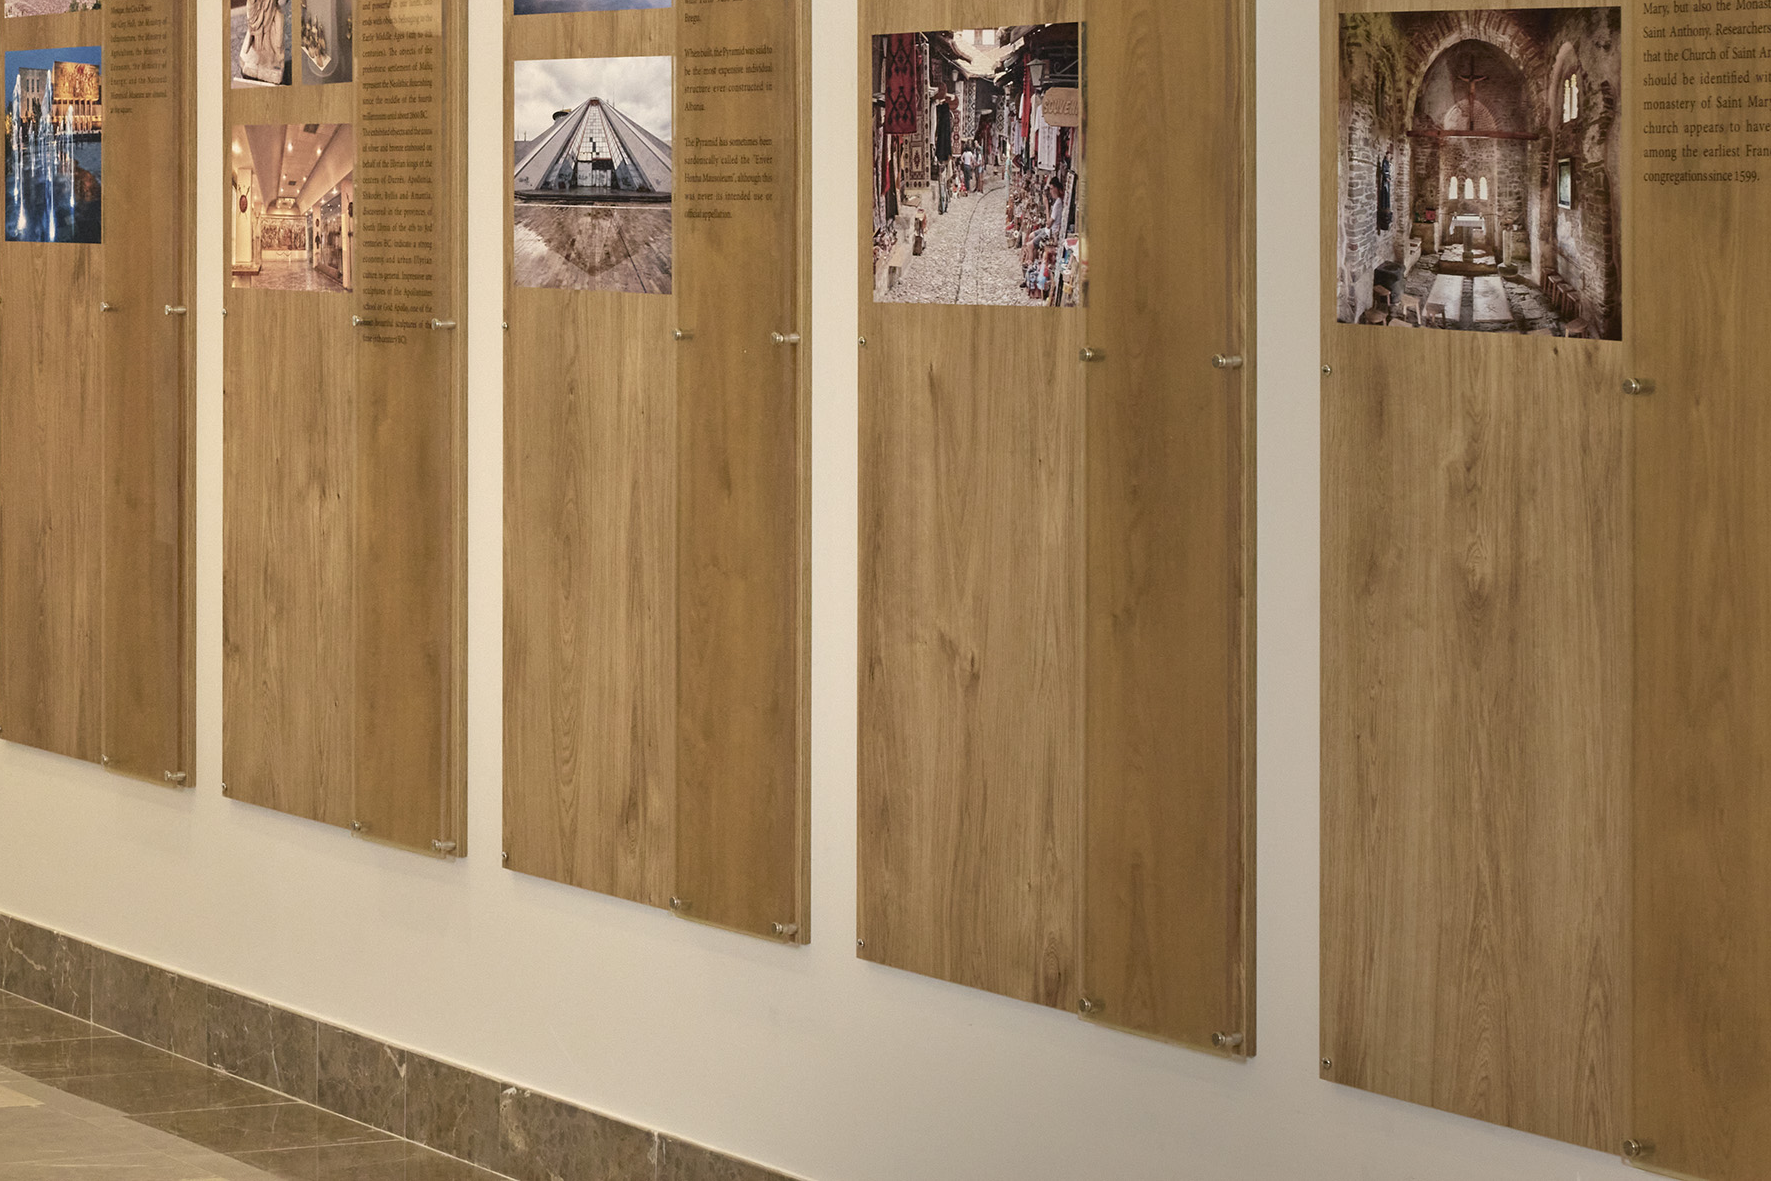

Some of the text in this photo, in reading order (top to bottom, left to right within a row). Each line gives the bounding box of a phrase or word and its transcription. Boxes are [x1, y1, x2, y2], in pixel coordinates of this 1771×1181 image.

[1643, 24, 1711, 39] Saint Anthony.
[1643, 47, 1755, 63] that the Church of Saint
[1643, 70, 1749, 86] should be identified
[1644, 95, 1741, 111] monastery of Saint
[1643, 121, 1740, 136] church appears to
[1644, 144, 1739, 160] among the earliest
[1643, 170, 1759, 184] congregations since 1599.
